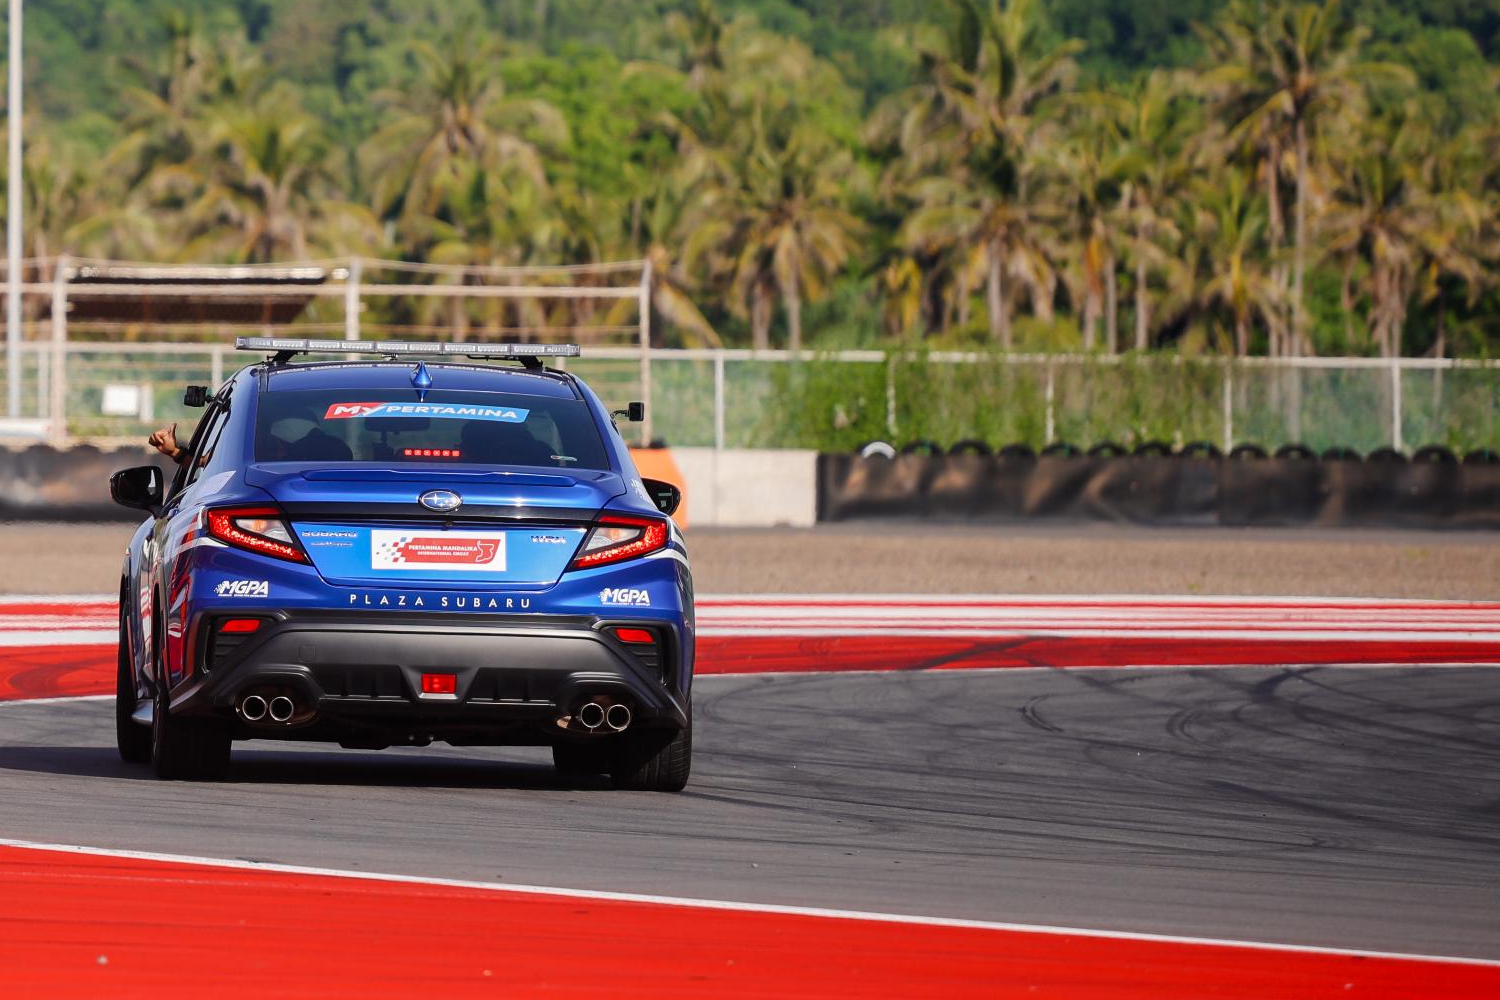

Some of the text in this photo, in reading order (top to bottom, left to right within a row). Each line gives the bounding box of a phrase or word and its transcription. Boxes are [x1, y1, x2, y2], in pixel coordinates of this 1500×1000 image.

[531, 535, 566, 544] WRX
[218, 580, 269, 595] MGPA
[349, 594, 530, 608] PLAZA SUBARU
[600, 587, 651, 603] MGPA
